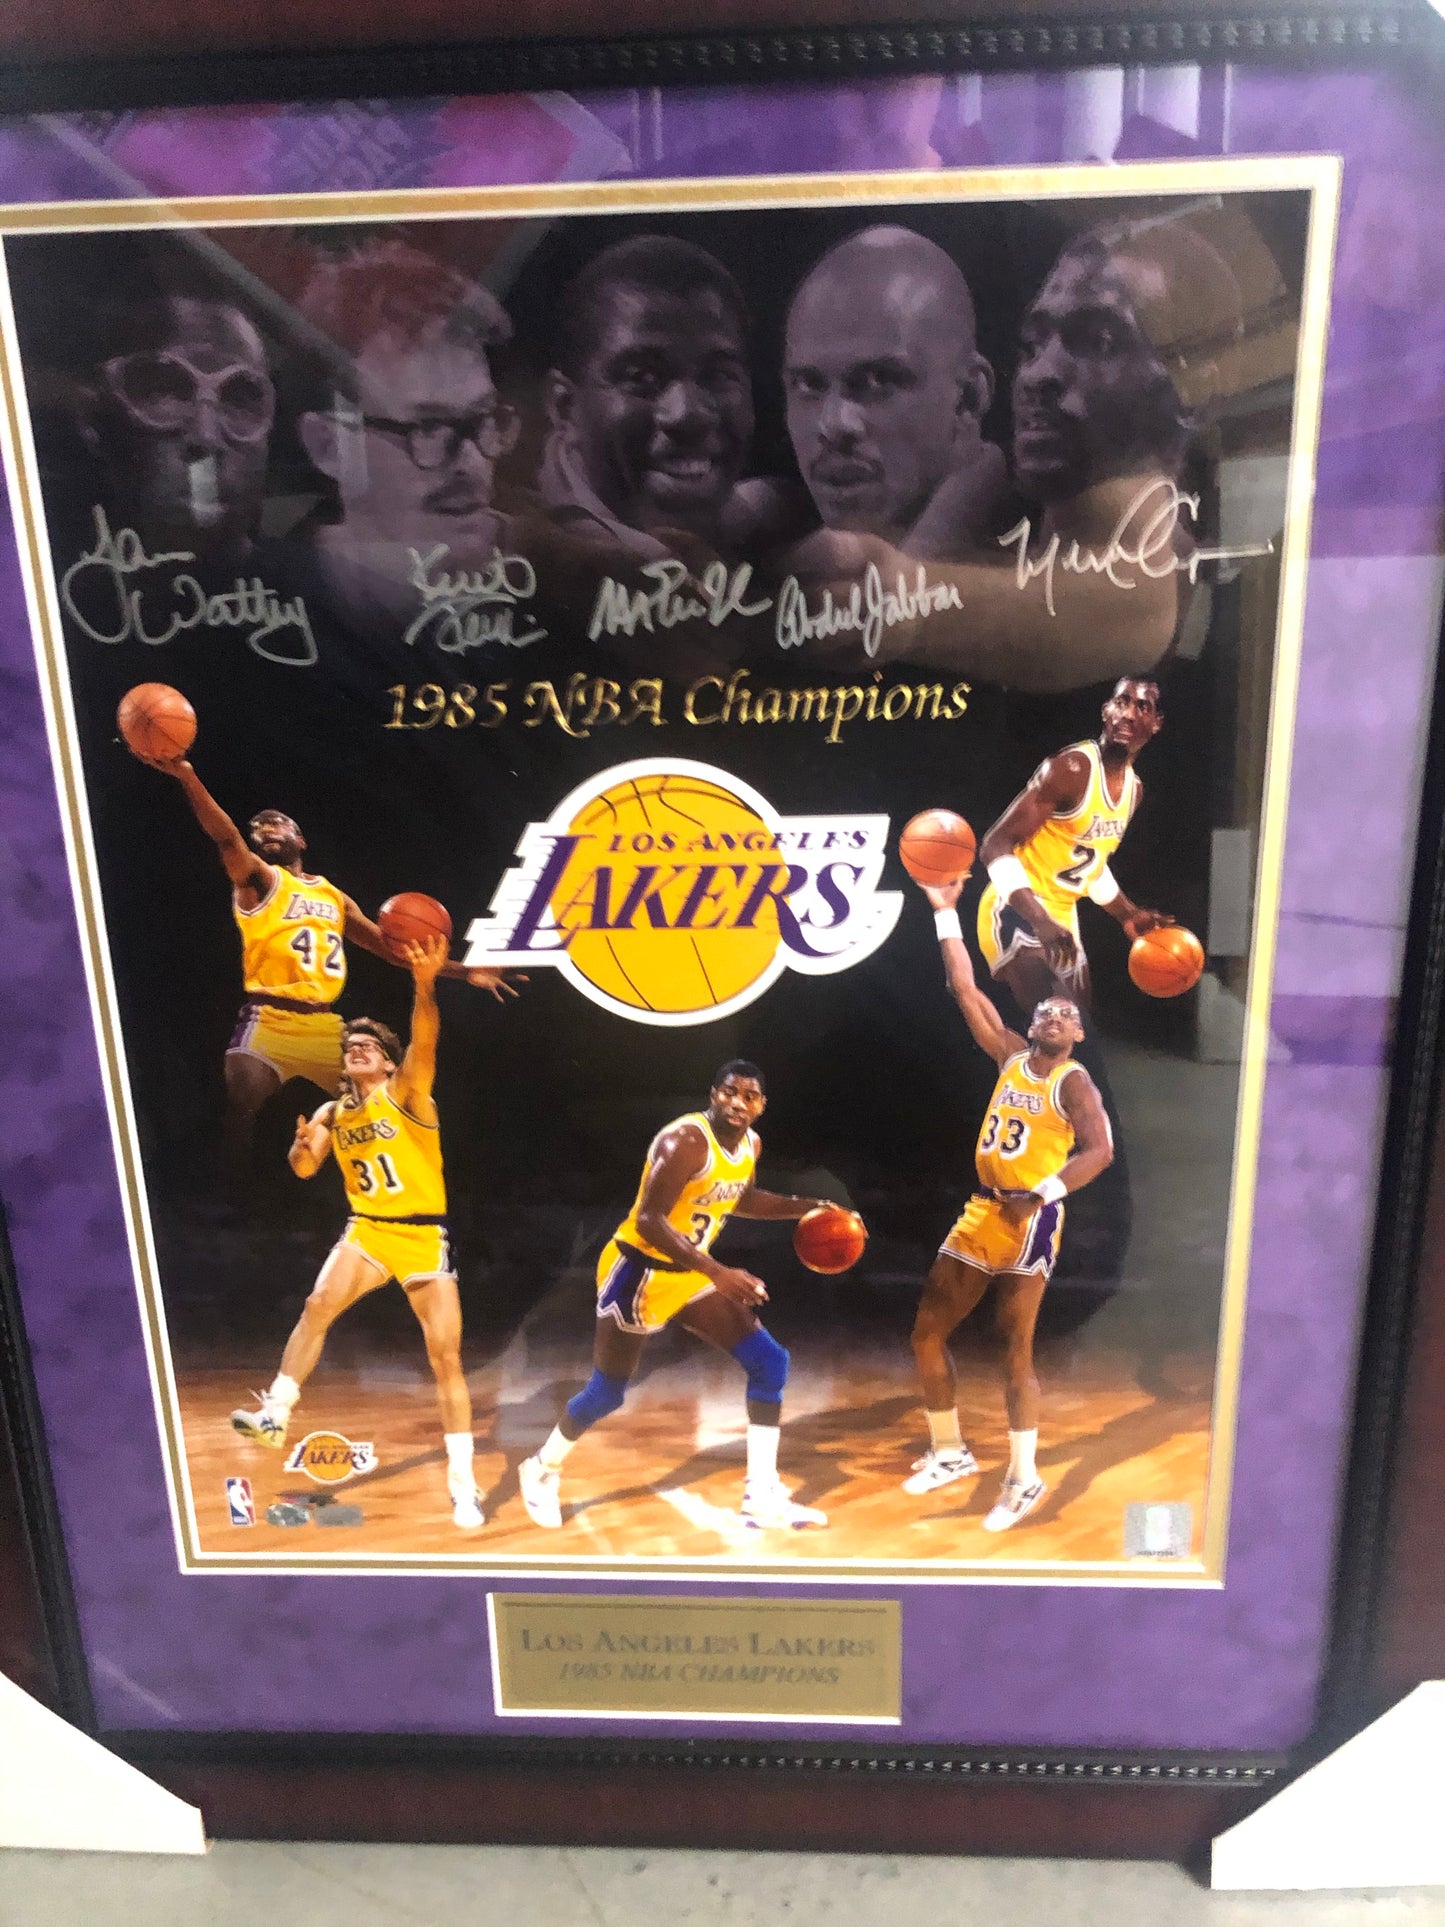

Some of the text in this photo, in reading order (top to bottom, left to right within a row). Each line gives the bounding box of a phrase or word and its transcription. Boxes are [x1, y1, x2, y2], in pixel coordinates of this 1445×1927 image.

[382, 668, 972, 743] 1985 NBA Champions
[606, 830, 870, 852] LOS ANGELES
[486, 834, 866, 957] LAKERS
[290, 928, 343, 971] 42
[332, 1118, 398, 1151] LAKERS
[981, 1113, 1026, 1155] 33
[350, 1152, 398, 1193] 31
[291, 1445, 369, 1471] LAKERS
[520, 1628, 585, 1653] LOS
[748, 1632, 876, 1657] LAKERS
